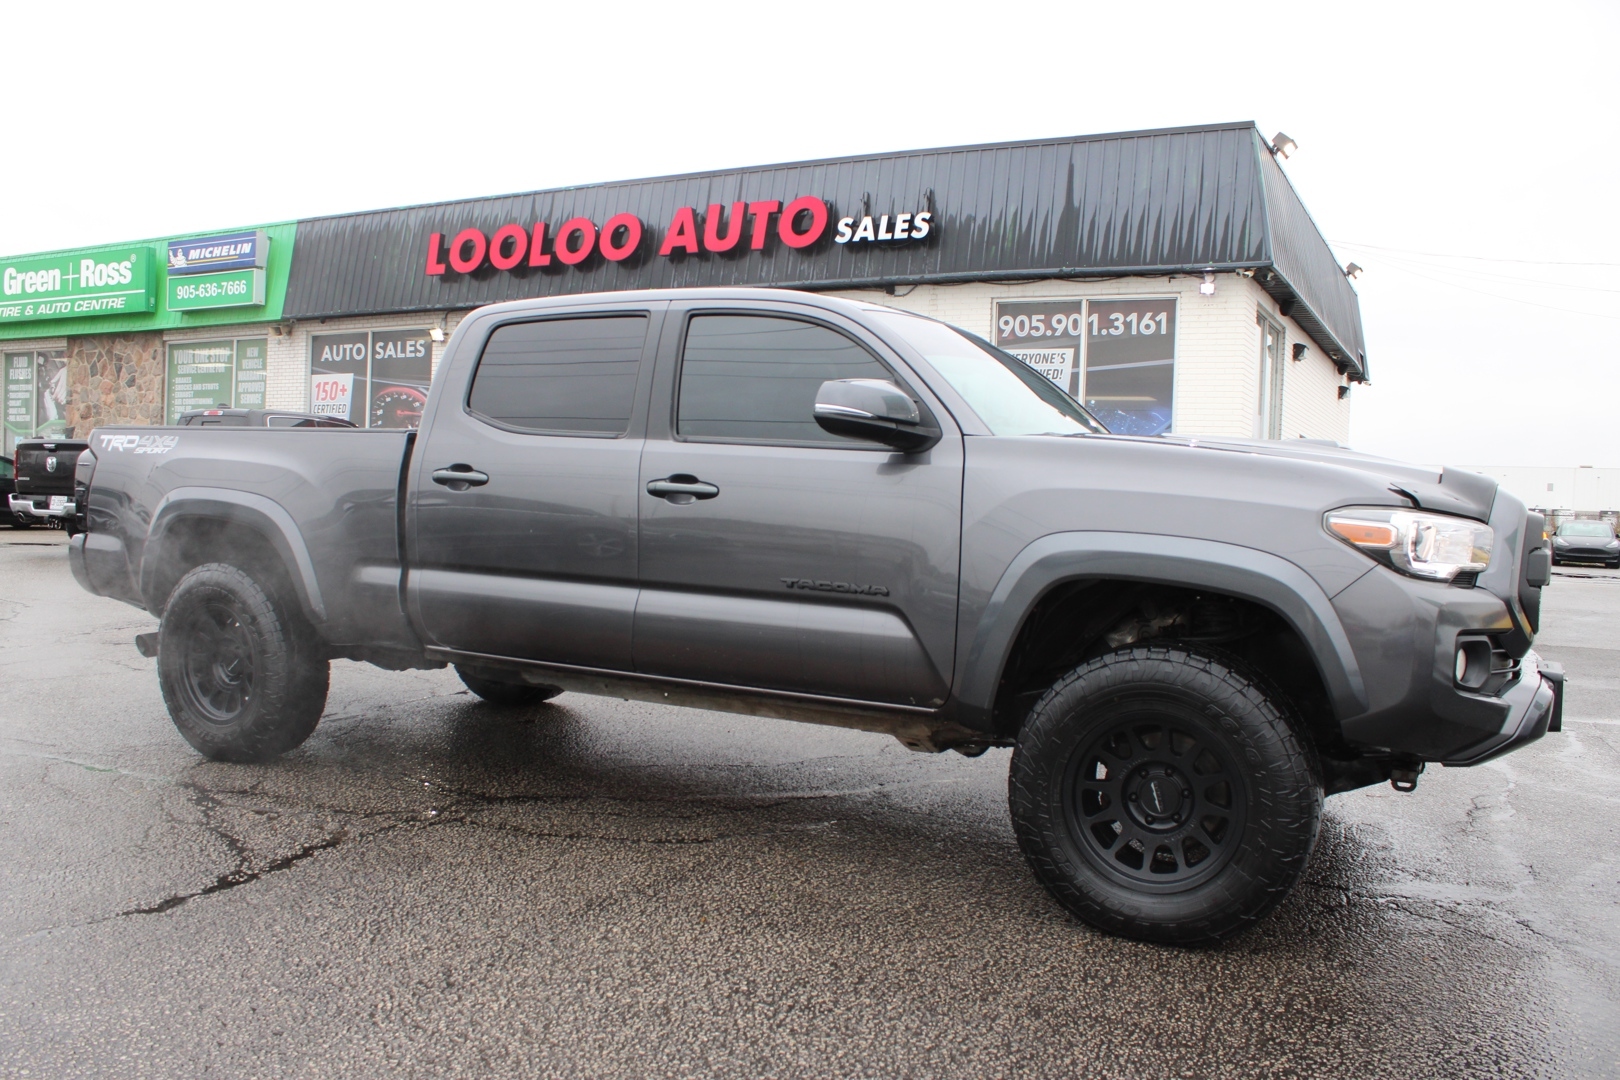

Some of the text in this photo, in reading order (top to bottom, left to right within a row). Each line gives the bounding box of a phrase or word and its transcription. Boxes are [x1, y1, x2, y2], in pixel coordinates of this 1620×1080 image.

[426, 196, 932, 276] LOOLOO AUTO SALES
[188, 242, 252, 261] MICHELIN
[4, 267, 61, 296] Green
[177, 280, 247, 299] 905-636-7666
[25, 305, 34, 315] &
[37, 301, 71, 315] AUTO
[74, 297, 126, 311] CENTRE
[999, 312, 1168, 338] 905.901.3161
[174, 349, 194, 364] YOUR
[320, 340, 425, 361] AUTO SALES
[242, 359, 263, 370] VEHICLE
[238, 382, 265, 393] APPROVED
[315, 381, 348, 401] 150+
[241, 394, 262, 404] SERVICE
[313, 403, 347, 414] CERTIFIED
[100, 434, 140, 452] TRD
[780, 578, 890, 597] TACOMA
